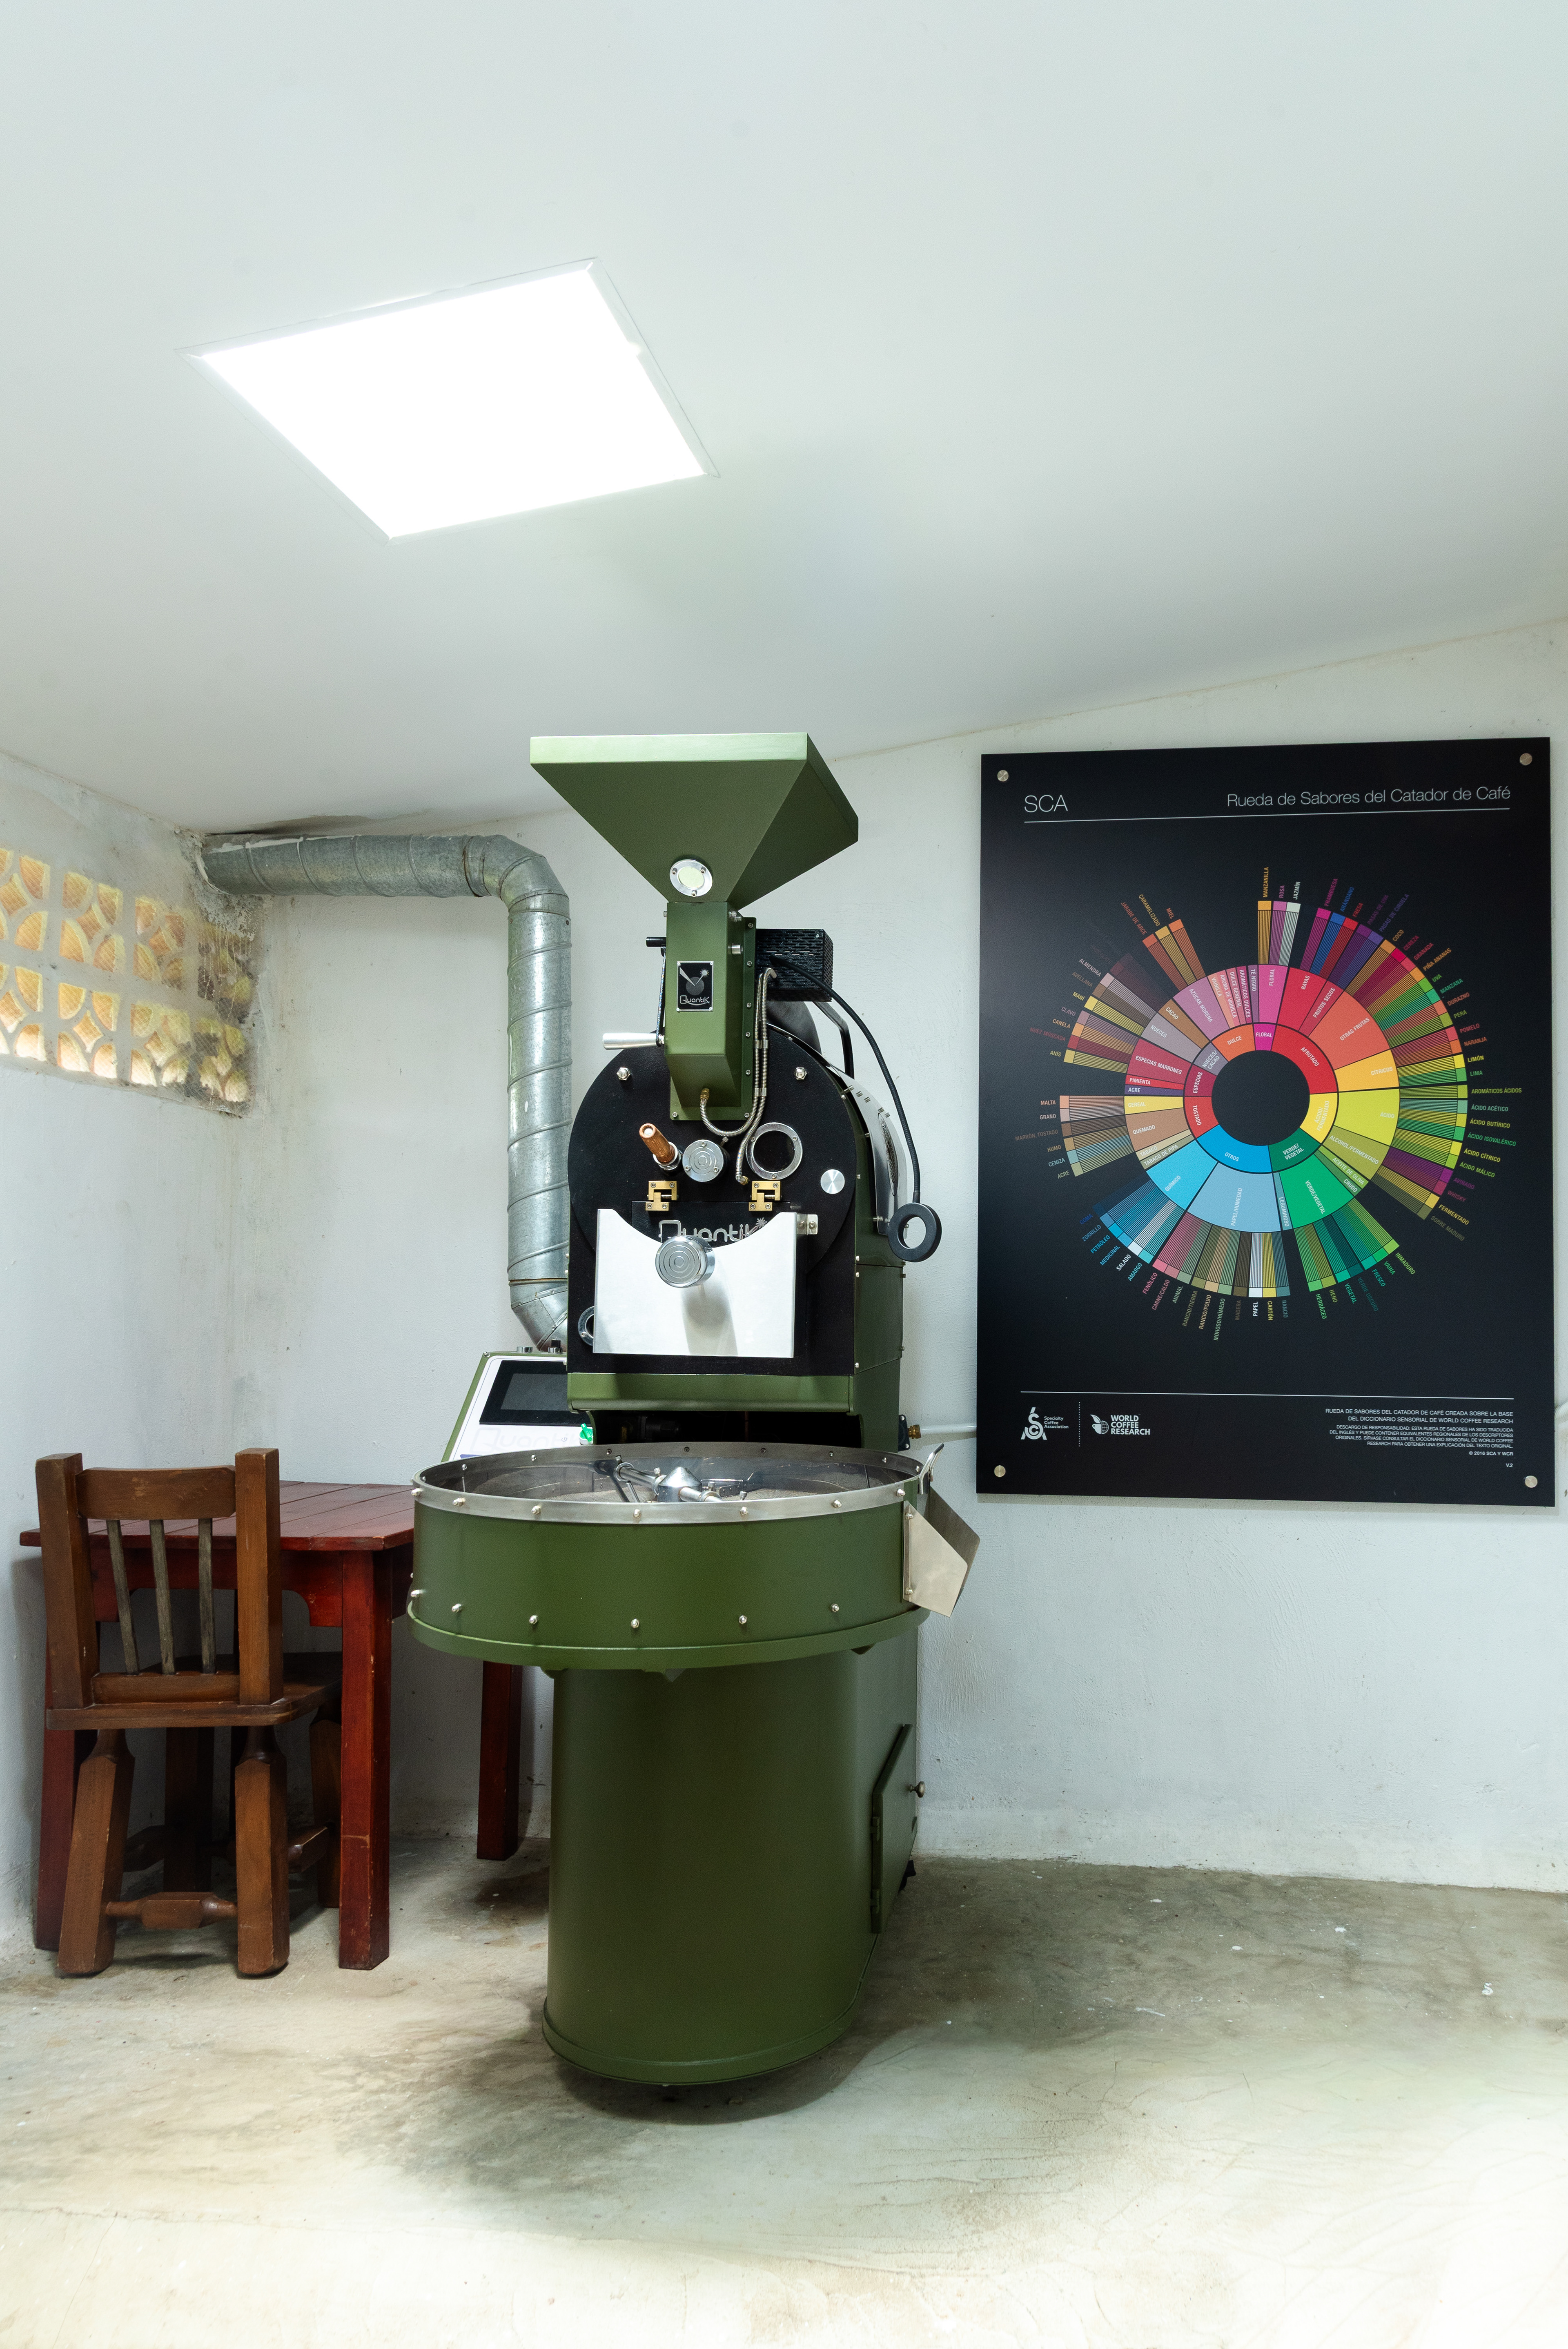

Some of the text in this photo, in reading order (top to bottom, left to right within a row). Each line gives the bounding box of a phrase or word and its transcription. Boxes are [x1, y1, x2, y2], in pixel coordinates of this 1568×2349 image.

[1025, 795, 1068, 812] SCA
[1227, 786, 1510, 807] Rueda de Sabores del Catador de Café
[1340, 887, 1354, 912] ARÁNDANO
[1138, 894, 1160, 926] CARAMELIZADO
[1166, 908, 1174, 919] MIEL
[1352, 903, 1363, 917] FRESA
[1392, 929, 1404, 942] COCO
[1079, 958, 1101, 977] ALMENDRA
[1423, 948, 1452, 971] PIÑA ANANAS
[1212, 977, 1222, 997] VAINILLA
[1239, 969, 1249, 999] AROMÁTICOS
[1301, 975, 1310, 990] BAYAS
[1432, 974, 1442, 982] UVA
[1440, 978, 1463, 994] MANZANA
[1072, 992, 1085, 1001] MANÍ
[1225, 990, 1230, 998] DE
[1313, 987, 1336, 1018] FRUTOS SECOS
[1447, 992, 1470, 1006] DURAZNO
[1061, 1007, 1076, 1016] CLAVO
[1165, 1007, 1179, 1020] CACAO
[1189, 988, 1213, 1023] AZÚCAR MORENA
[1227, 997, 1237, 1018] VAINILLA
[1453, 1010, 1467, 1018] PERA
[1053, 1018, 1070, 1029] CANELA
[1151, 1025, 1167, 1038] NUECES
[1340, 1017, 1370, 1041] OTRAS FRUTAS
[1227, 1036, 1242, 1045] DULCE
[1464, 1037, 1487, 1046] NARANJA
[1136, 1055, 1182, 1074] ESPECIAS MARRONES
[1202, 1050, 1217, 1068] NUECES/
[1207, 1056, 1220, 1069] CACAO
[1301, 1047, 1319, 1066] AFRUTADO
[1371, 1066, 1393, 1075] CÍTRICOS
[1193, 1072, 1203, 1094] ESPECIAS
[1192, 1105, 1202, 1125] TOSTADO
[1314, 1106, 1323, 1123] ÁCIDO/
[1316, 1101, 1330, 1131] FERMENTADO
[1133, 1125, 1156, 1134] QUEMADO
[1283, 1143, 1299, 1155] VERDE/
[1330, 1135, 1379, 1164] ALCOHOL/FERMENTADO
[1484, 1135, 1516, 1146] ISOVALÉRICO
[1048, 1158, 1065, 1167] CENIZA
[1144, 1154, 1161, 1166] TABACO
[1168, 1144, 1178, 1153] PIPA
[1225, 1152, 1239, 1162] OTROS
[1285, 1147, 1304, 1160] VEGETAL
[1463, 1148, 1501, 1162] ÁCIDO CÍTRICO
[1057, 1170, 1069, 1179] ACRE
[1332, 1157, 1347, 1171] ACEITE
[1352, 1174, 1365, 1185] OLIVA
[1459, 1161, 1495, 1178] ÁCIDO MÁLICO
[1165, 1175, 1181, 1192] QUÍMICO
[1343, 1179, 1358, 1192] CRUDO
[1305, 1180, 1326, 1215] VERDE/VEGETAL
[1231, 1188, 1243, 1226] PAPEL/HUMEDAD
[1279, 1197, 1290, 1227] LEGUMINOSO
[1438, 1204, 1469, 1225] FERMENTADO
[1082, 1225, 1101, 1241] ZORRILLO
[1091, 1235, 1110, 1254] PETRÓLEO
[1100, 1245, 1120, 1266] MEDICINAL
[1116, 1254, 1131, 1271] SALADO
[1395, 1252, 1415, 1275] INMADURO
[1127, 1262, 1143, 1281] AMARGO
[1384, 1261, 1395, 1275] VAINA
[1143, 1273, 1158, 1294] FENÓLICO
[1372, 1269, 1386, 1287] FRESCO
[1152, 1279, 1170, 1310] CARNE/CALDO
[1172, 1286, 1183, 1304] ANIMAL
[1329, 1289, 1338, 1303] HENO
[1344, 1283, 1357, 1304] VEGETAL
[1198, 1295, 1212, 1329] RANCIO/POLVO
[1315, 1294, 1327, 1319] HERBÁCEO
[1213, 1298, 1225, 1341] MOHOSO/HÚMEDO
